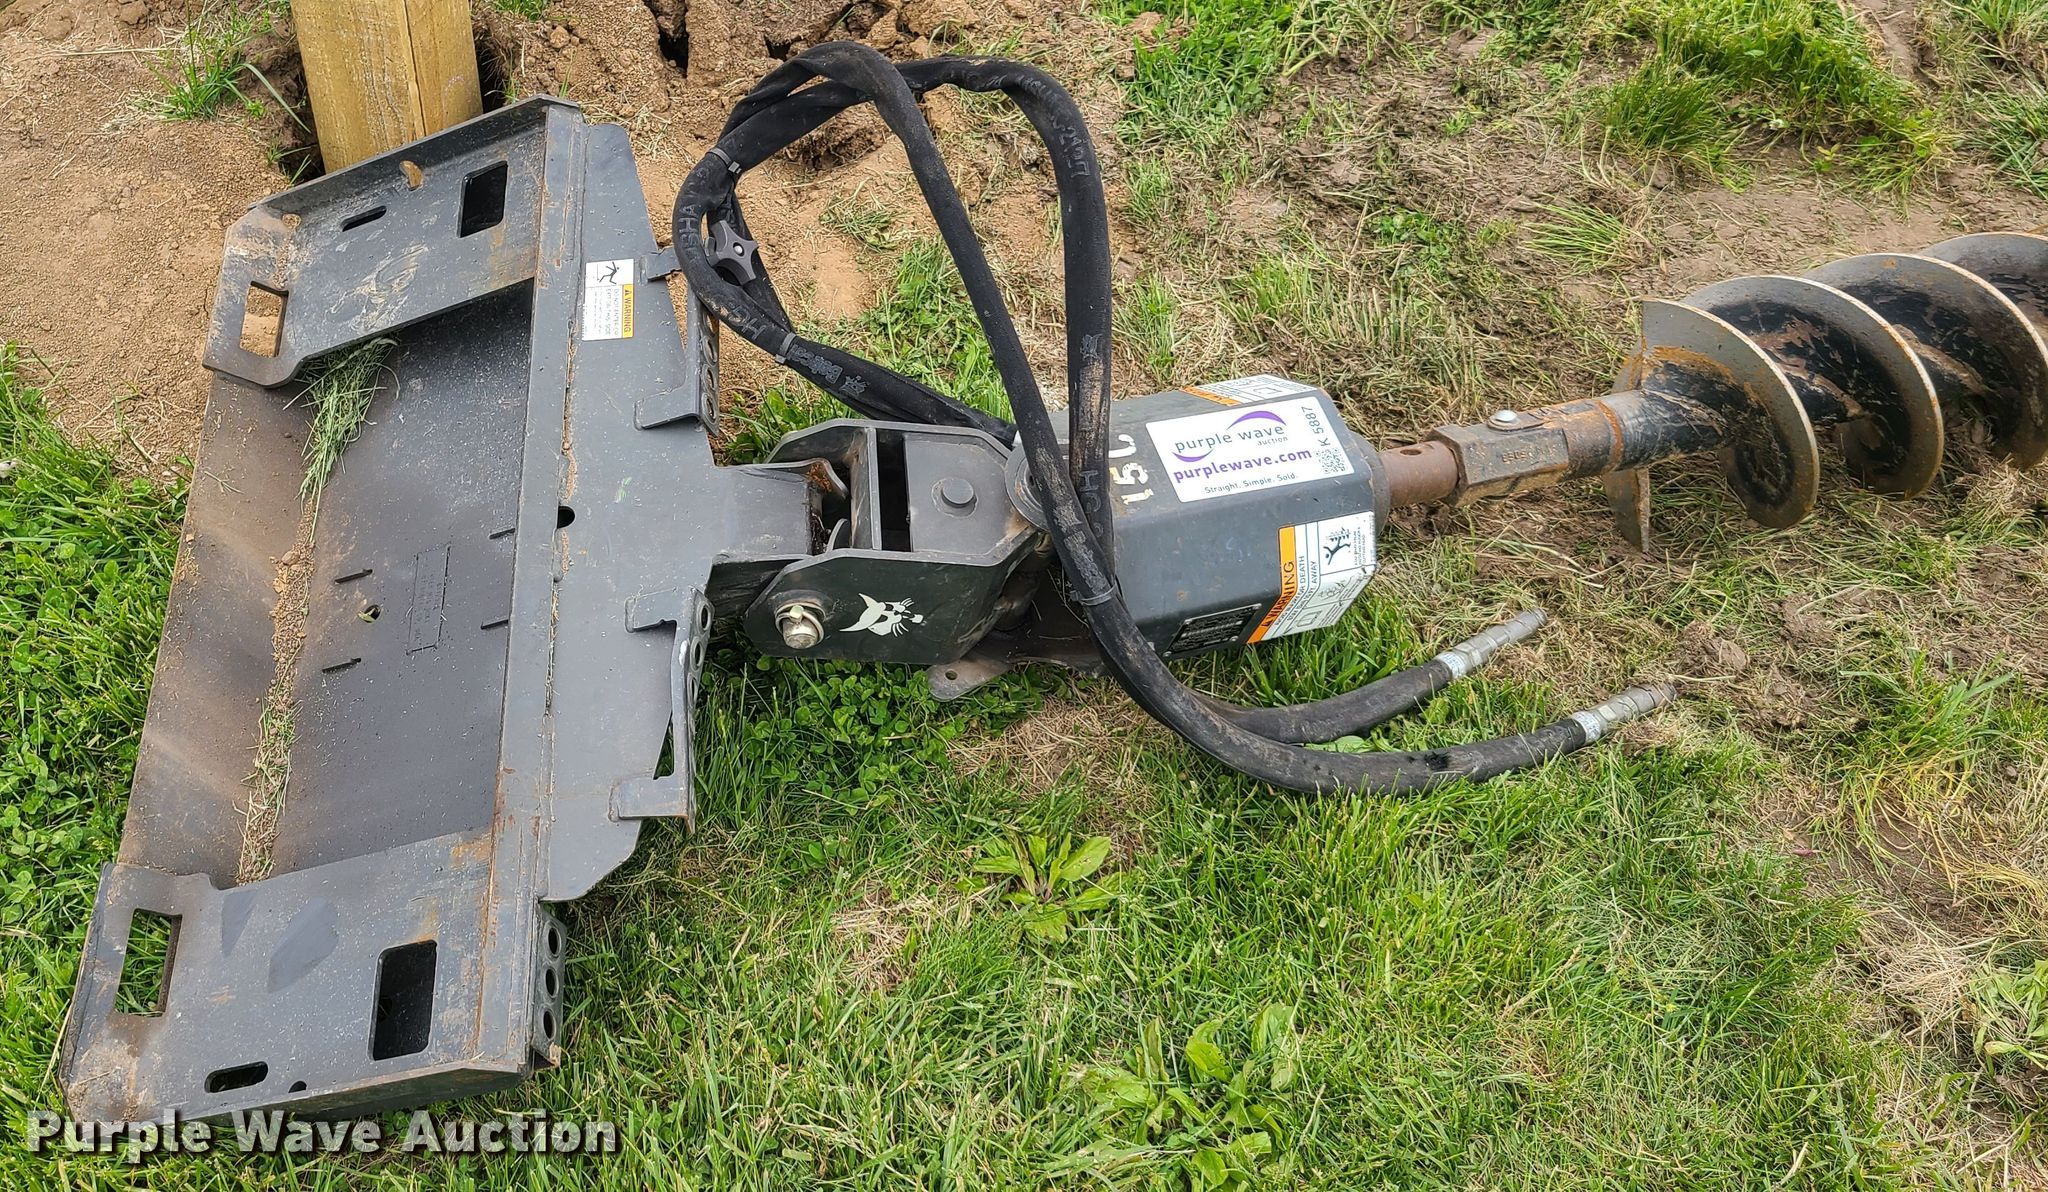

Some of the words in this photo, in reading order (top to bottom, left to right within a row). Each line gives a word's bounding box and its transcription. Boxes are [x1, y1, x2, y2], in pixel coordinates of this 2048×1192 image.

[623, 297, 632, 333] WARNING
[1301, 406, 1324, 434] 5887
[1174, 433, 1233, 453] purple
[1238, 425, 1285, 441] wave
[1257, 436, 1288, 446] auction
[1318, 437, 1331, 447] K
[1173, 450, 1312, 483] purplewave.com
[1204, 482, 1242, 494] Straight.
[1243, 477, 1275, 488] Simple.
[1277, 472, 1297, 482] Sold.
[1310, 560, 1318, 584] AWAY
[1269, 561, 1295, 619] WARNING
